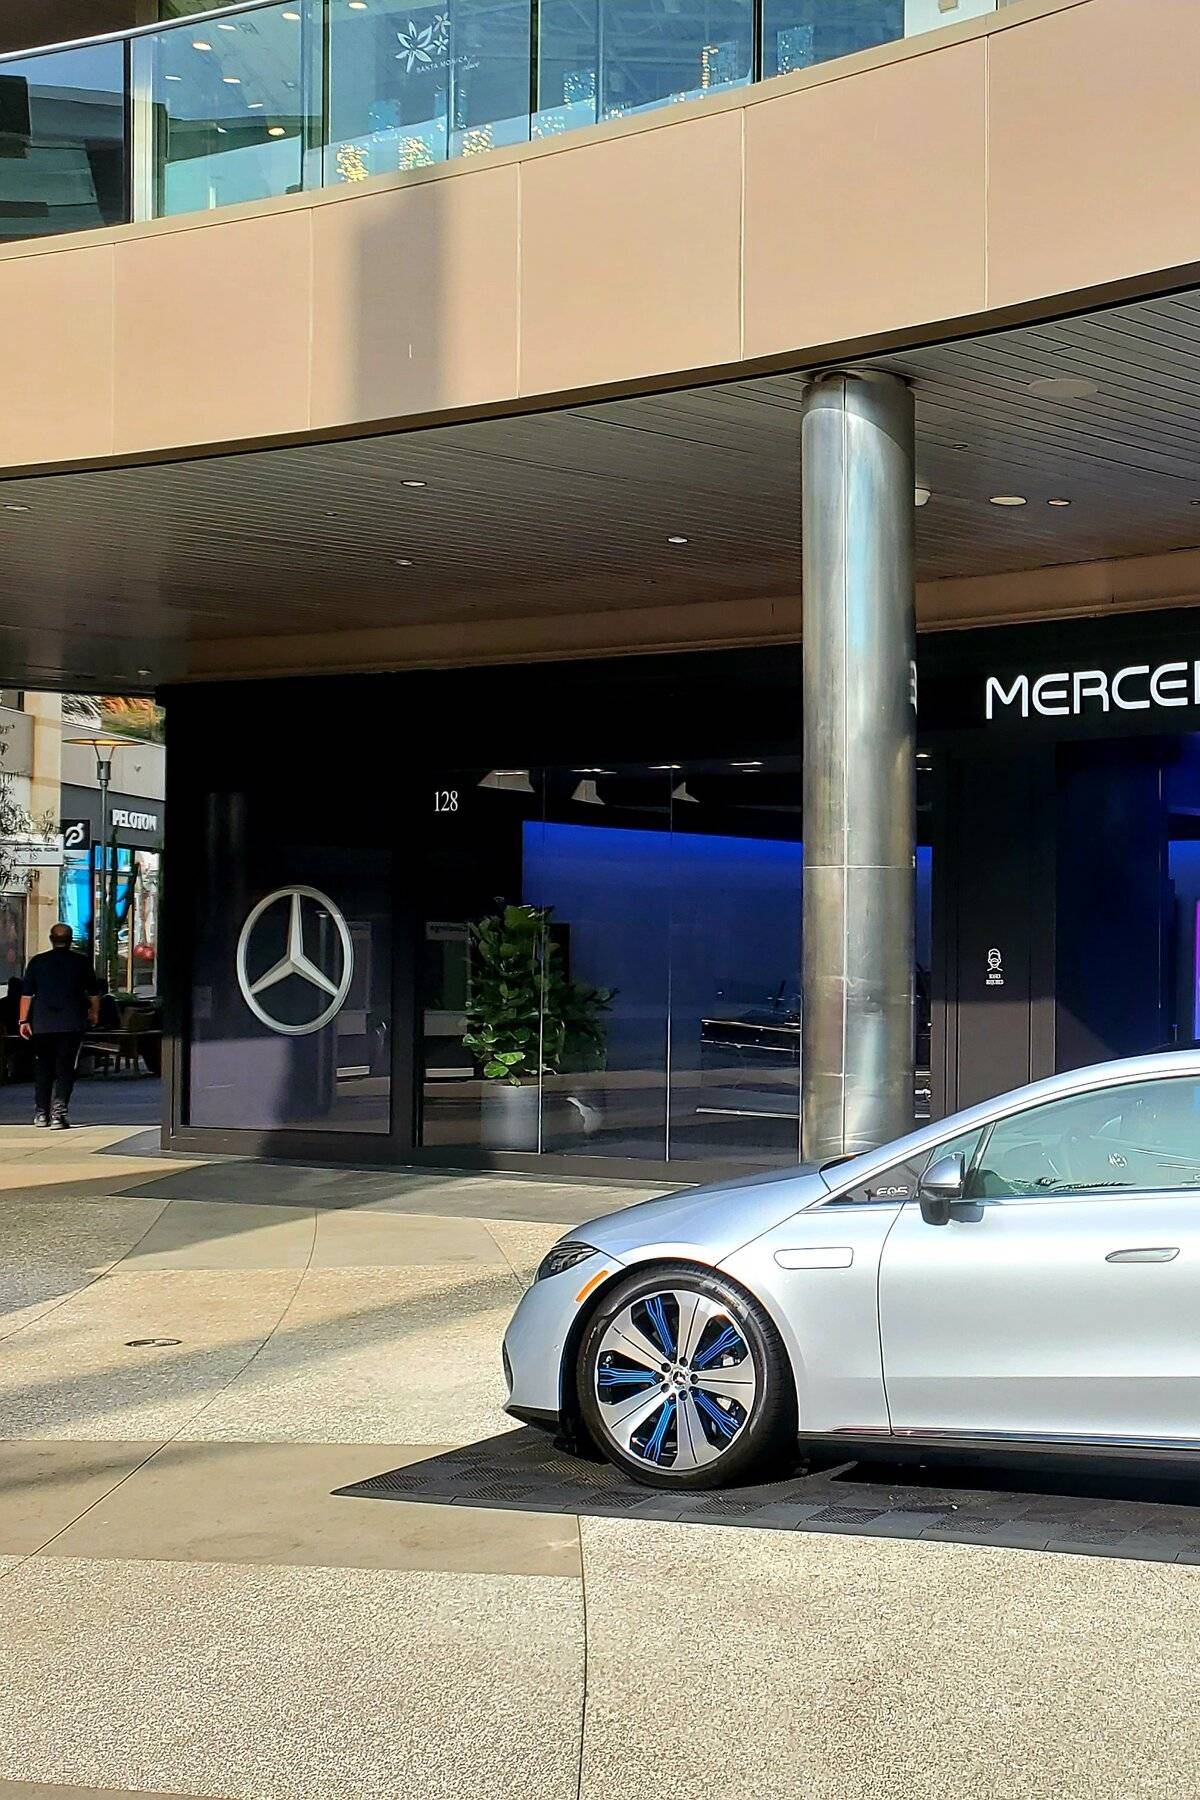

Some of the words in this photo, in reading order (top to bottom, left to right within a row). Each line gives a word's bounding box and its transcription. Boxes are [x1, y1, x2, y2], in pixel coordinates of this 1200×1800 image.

[434, 790, 458, 811] 128
[112, 809, 157, 831] PELOTON
[876, 1186, 908, 1197] EQS
